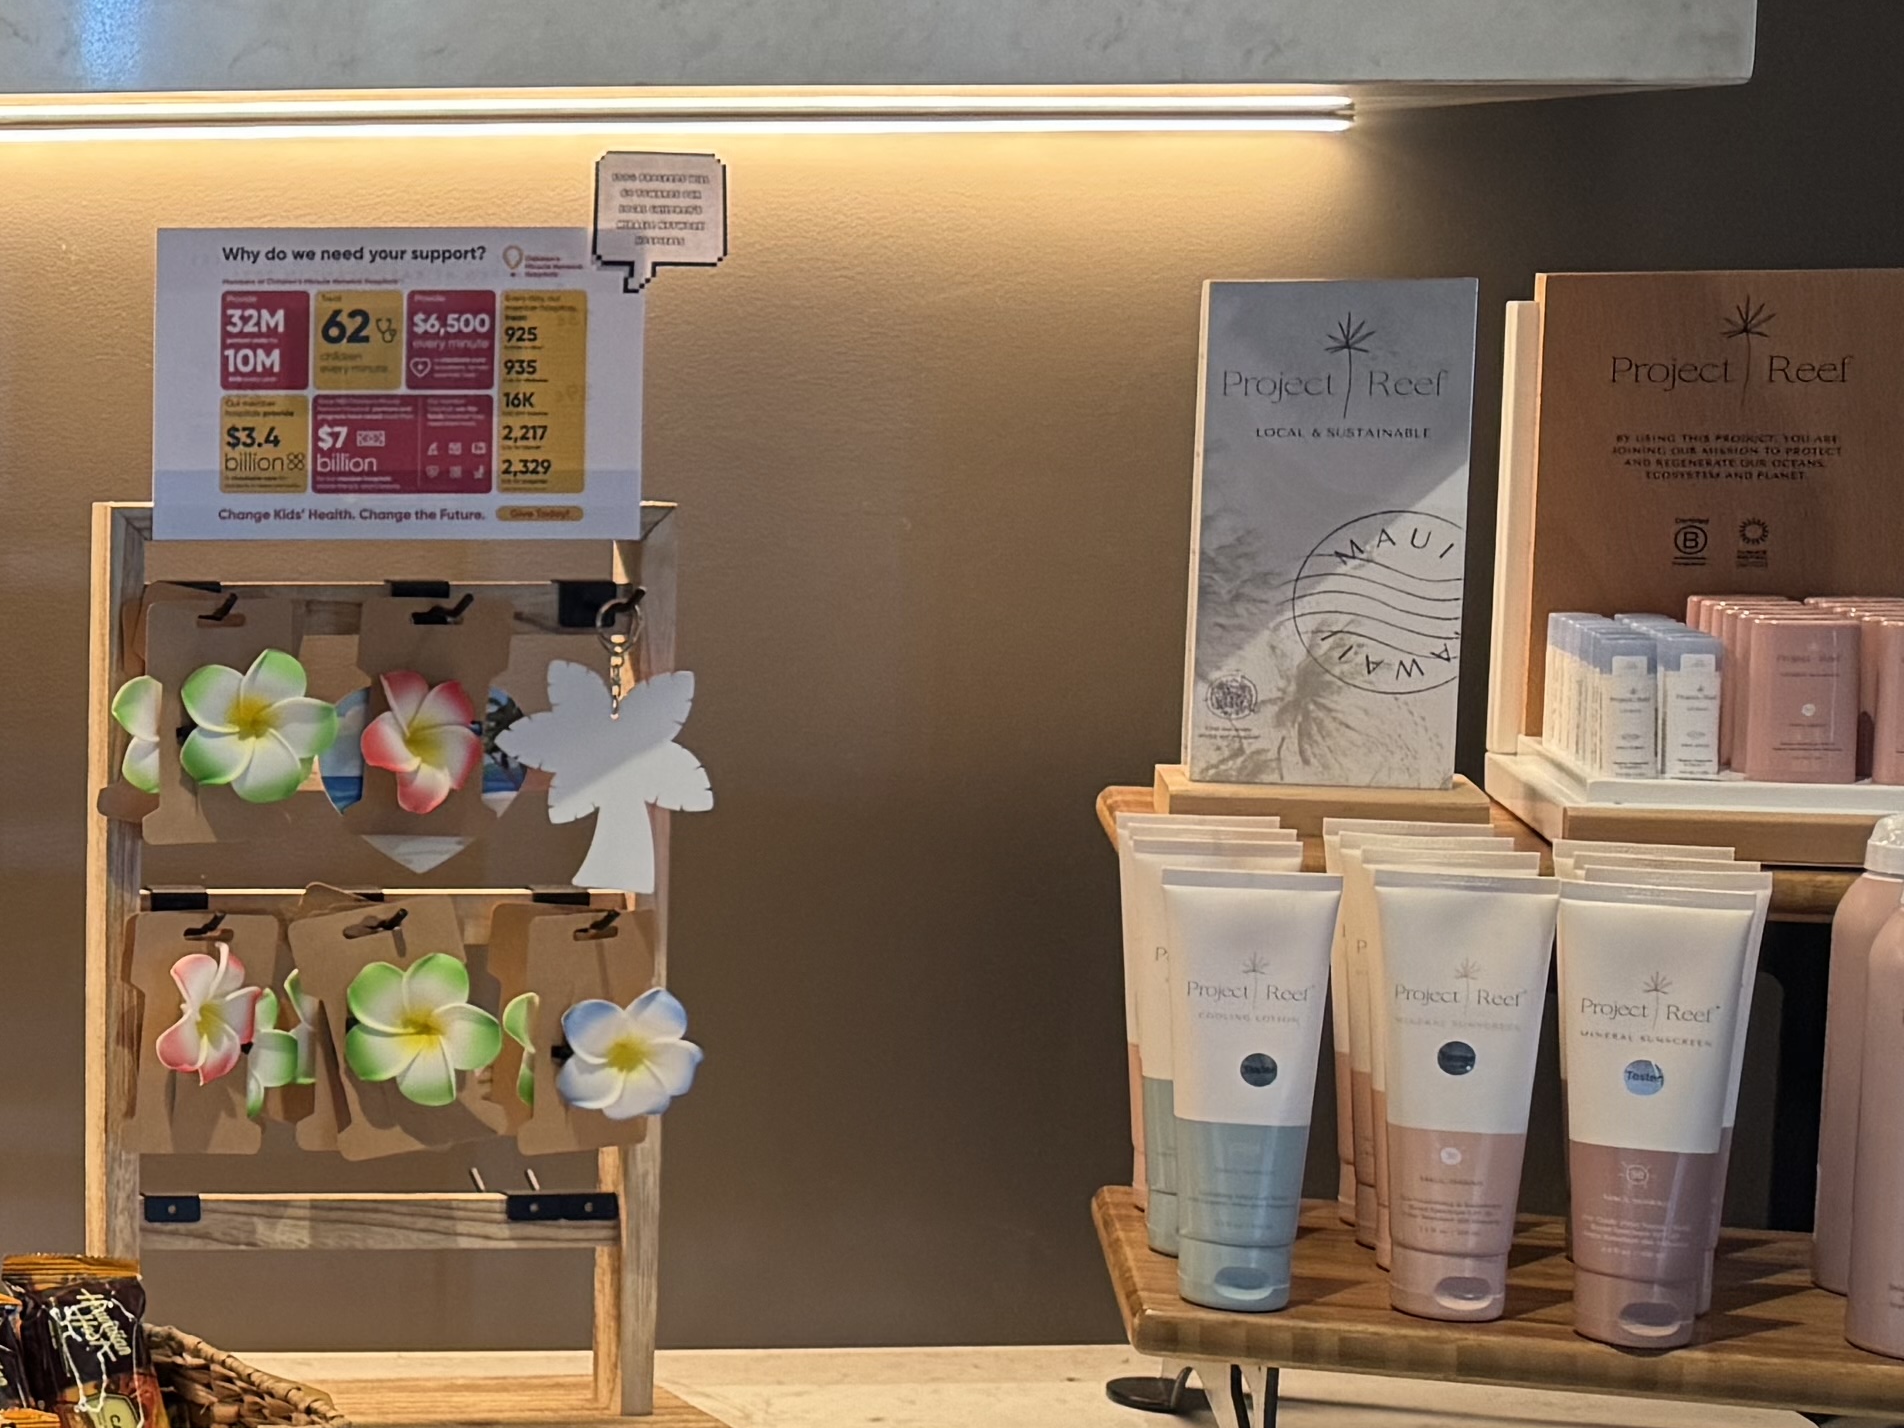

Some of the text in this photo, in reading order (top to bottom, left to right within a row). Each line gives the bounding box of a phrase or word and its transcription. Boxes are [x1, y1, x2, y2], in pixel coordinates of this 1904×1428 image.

[222, 246, 487, 264] Why do we need your support?
[226, 309, 285, 333] 32M
[321, 308, 371, 345] 62
[412, 312, 490, 337] $6,500
[504, 326, 538, 343] 925
[224, 348, 280, 373] 10M
[504, 359, 538, 375] 935
[1611, 355, 1854, 392] Project Reef
[1222, 369, 1448, 404] Project Reef
[503, 392, 534, 408] 16K
[226, 425, 281, 451] $3.4
[317, 424, 348, 451] $7
[502, 425, 548, 443] 2,217
[1256, 428, 1431, 439] LOCAL & SUSTAINABLE
[224, 452, 284, 472] billion
[316, 454, 377, 473] billion
[501, 459, 552, 478] 2,329
[218, 508, 270, 522] Change
[309, 508, 356, 521] Health.
[359, 508, 411, 522] Change
[415, 509, 436, 520] the
[440, 508, 486, 521] Future.
[1334, 527, 1454, 565] MAUI
[1186, 980, 1312, 1002] Project Reef
[1394, 983, 1522, 1008] Project Reef
[1198, 1011, 1251, 1022] COOLING
[1580, 997, 1712, 1022] Project Reef
[1580, 1030, 1712, 1048] MINERAL SUNSCREEN
[1626, 1070, 1664, 1084] Tester
